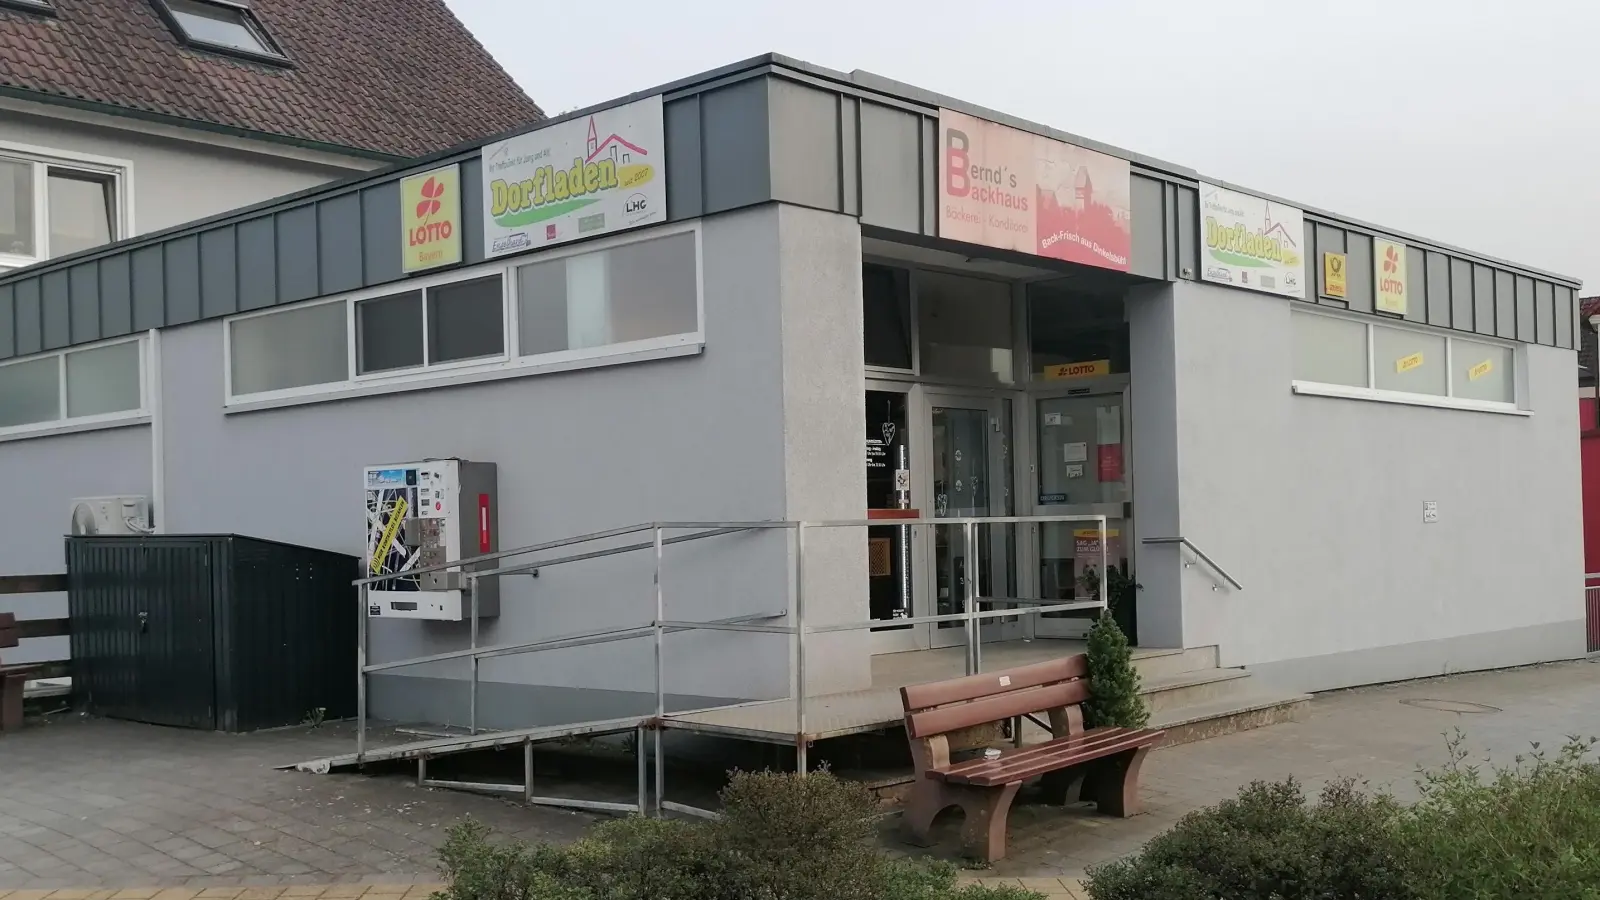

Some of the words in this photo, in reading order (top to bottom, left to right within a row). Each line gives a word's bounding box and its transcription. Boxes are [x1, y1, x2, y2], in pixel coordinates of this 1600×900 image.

[490, 157, 619, 217] Dorfladen
[626, 200, 647, 212] LHG
[946, 205, 981, 224] Bäckerei
[988, 214, 1029, 233] Konditorei
[409, 220, 452, 247] LOTTO
[1206, 216, 1282, 262] Dorfladen
[1042, 230, 1080, 249] Back-Frisch
[1081, 237, 1092, 249] aus
[1093, 242, 1127, 265] Dinkelsbühl
[1380, 276, 1403, 295] LOTTO
[1069, 365, 1095, 375] LOTTO
